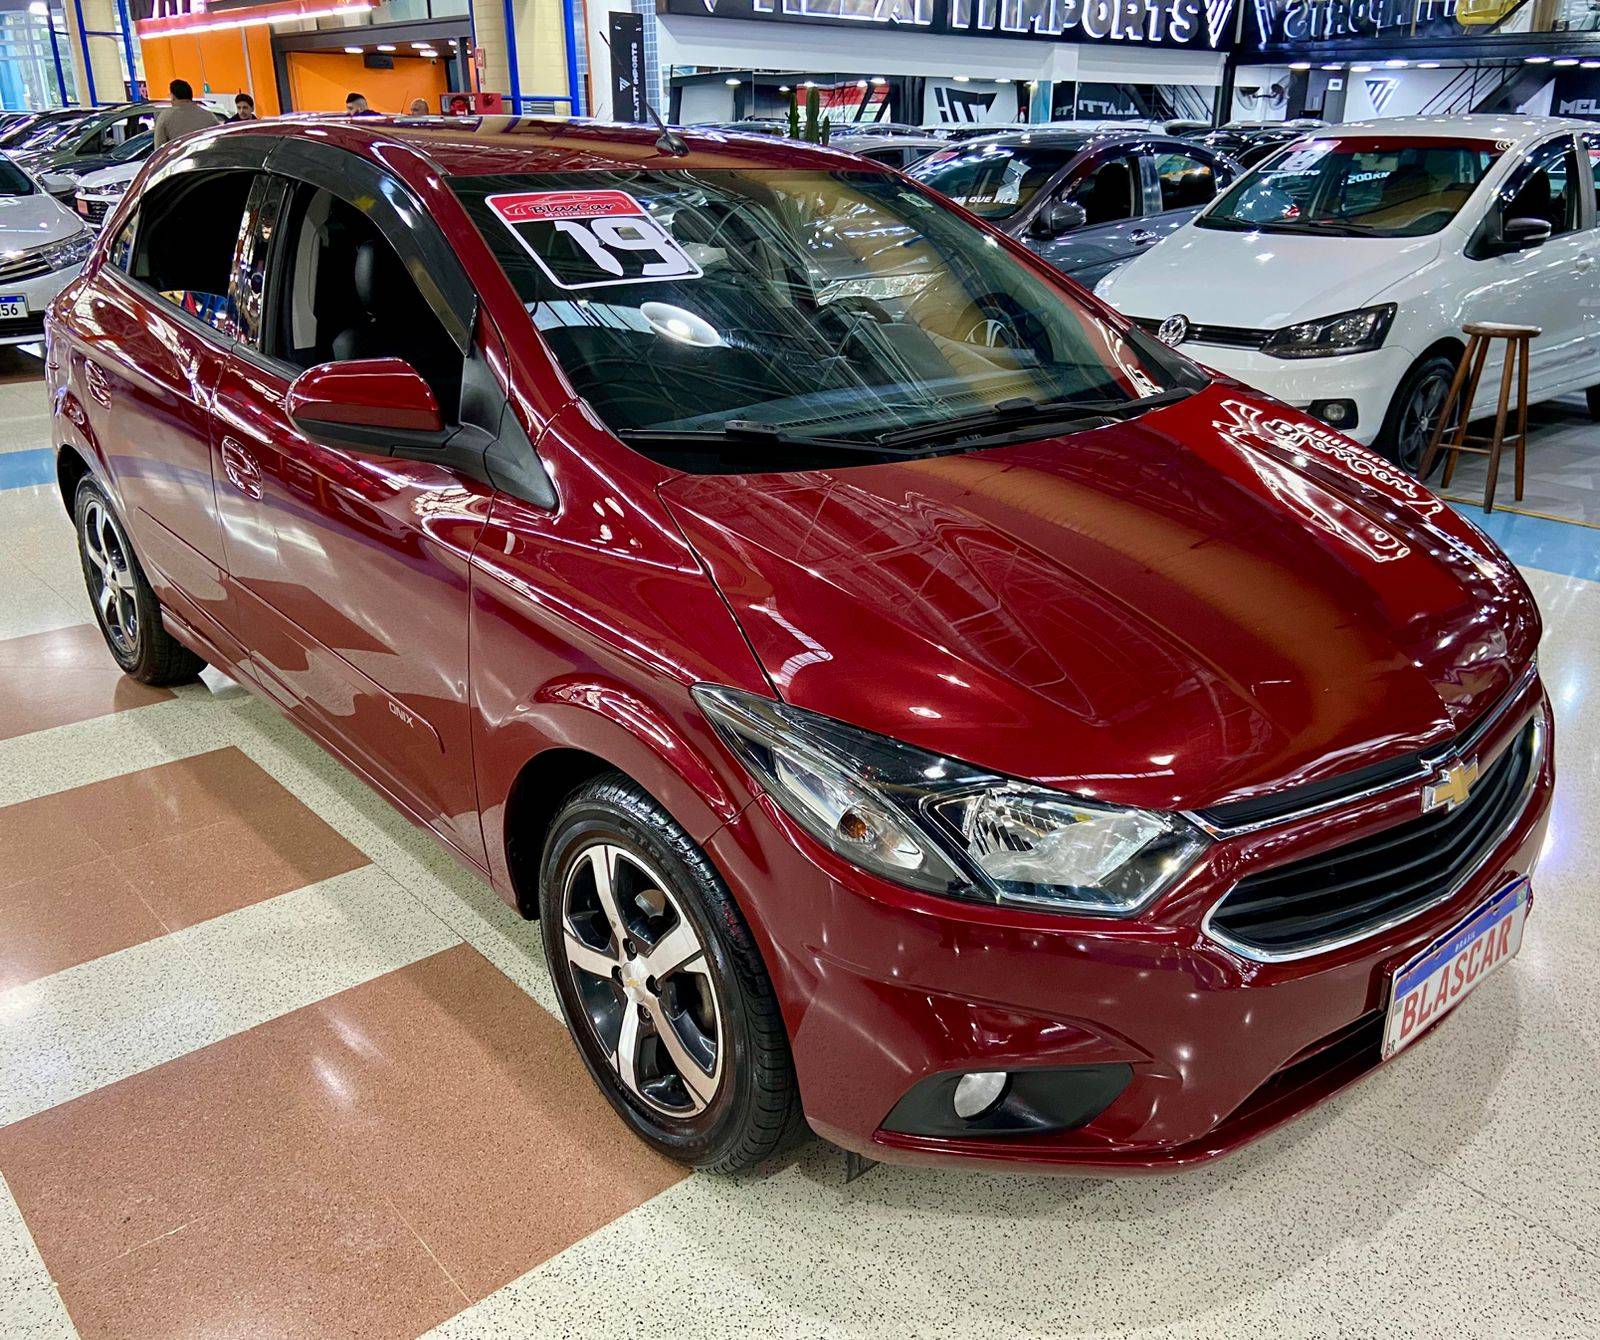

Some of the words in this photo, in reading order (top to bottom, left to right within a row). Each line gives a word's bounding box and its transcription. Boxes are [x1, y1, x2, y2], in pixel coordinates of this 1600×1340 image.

[530, 201, 615, 215] BlasCar
[553, 217, 690, 278] 19
[0, 303, 19, 317] 56
[388, 700, 414, 729] ONIX
[1399, 914, 1513, 1041] BLASCAR
